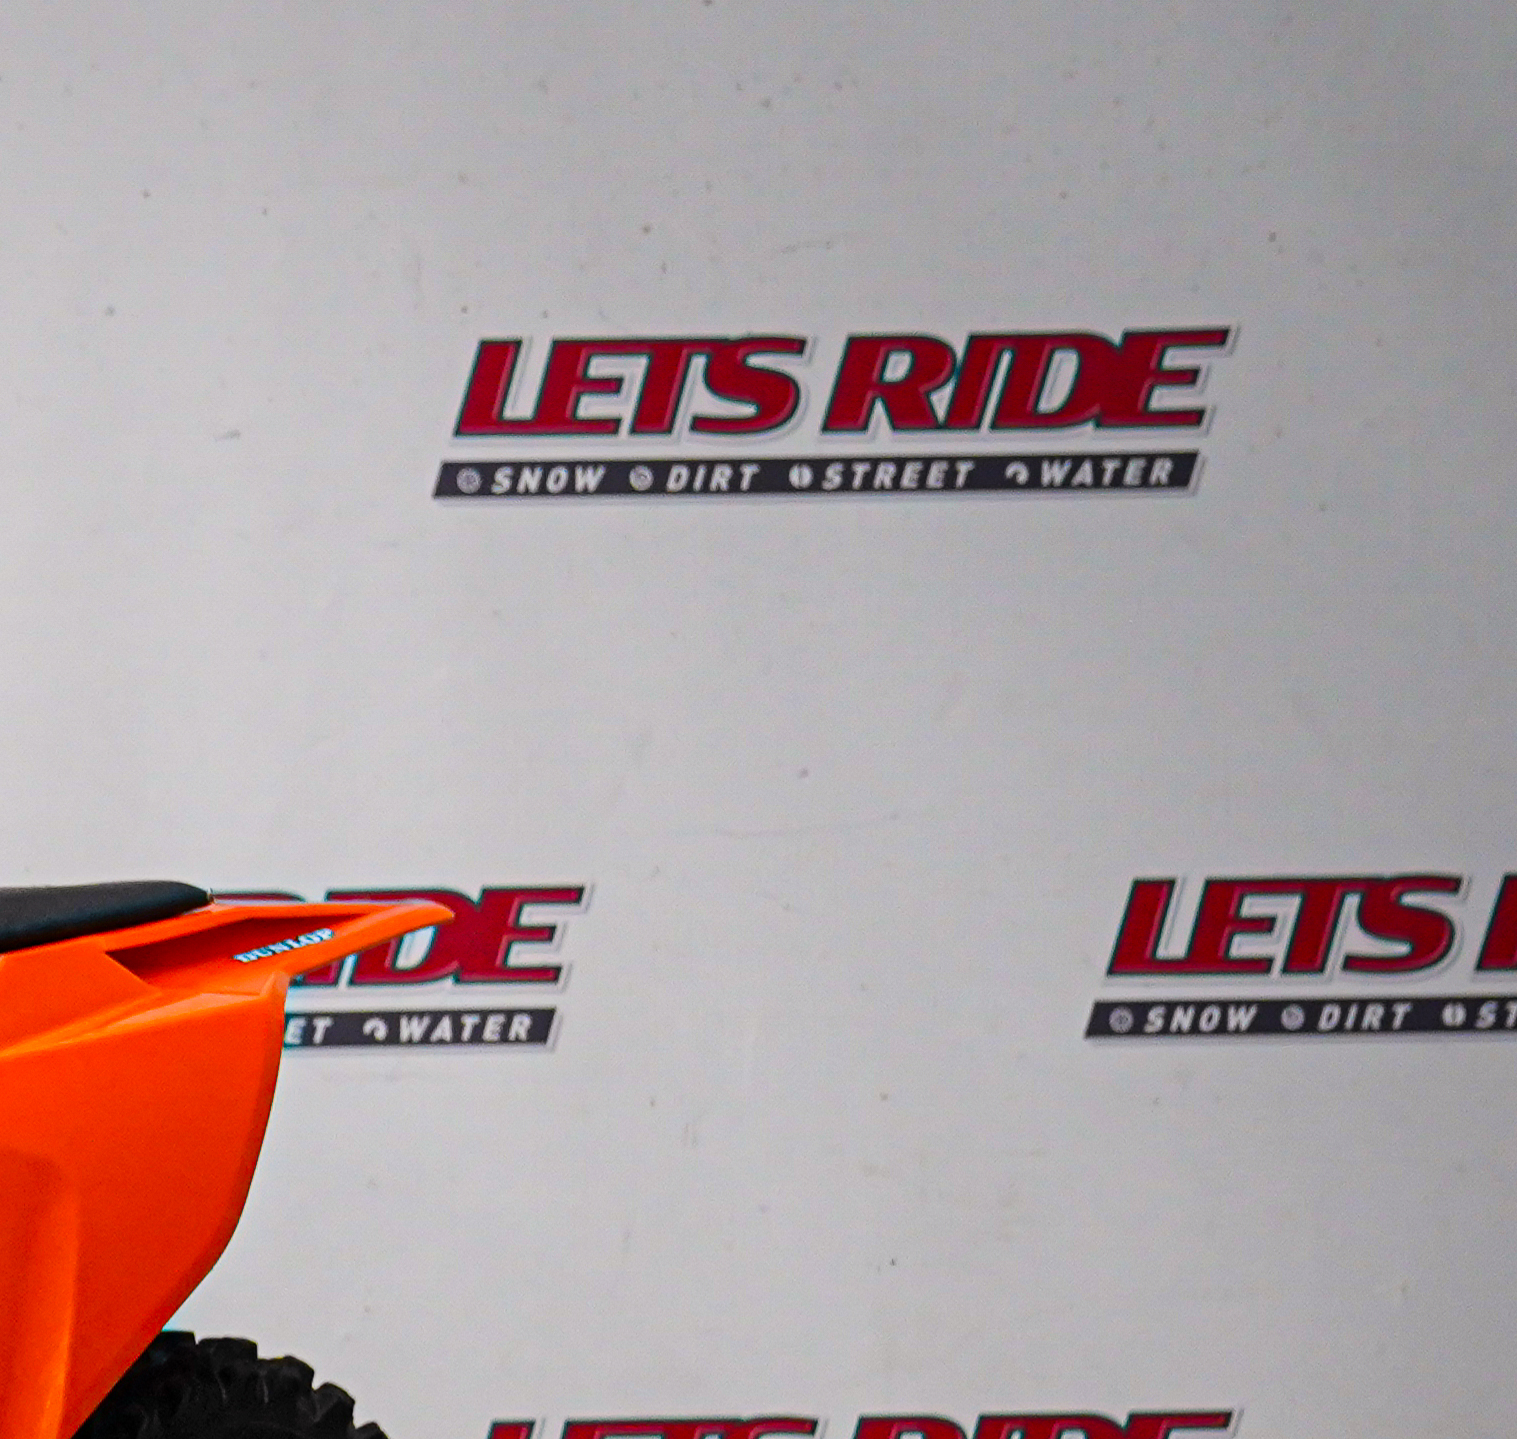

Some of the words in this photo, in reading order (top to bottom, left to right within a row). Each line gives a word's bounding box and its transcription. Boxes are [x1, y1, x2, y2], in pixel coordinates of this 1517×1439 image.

[453, 336, 806, 437] LETS
[820, 325, 1231, 434] RIDE
[490, 466, 605, 495] SNOW
[665, 463, 759, 493] DIRT
[822, 461, 974, 490] STREET
[1040, 458, 1174, 487] WATER
[1107, 876, 1462, 976] LETS
[233, 928, 334, 963] DUNLOP
[399, 1015, 533, 1044] WATER
[1143, 1005, 1258, 1034] SNOW
[1316, 1003, 1413, 1031] DIRT
